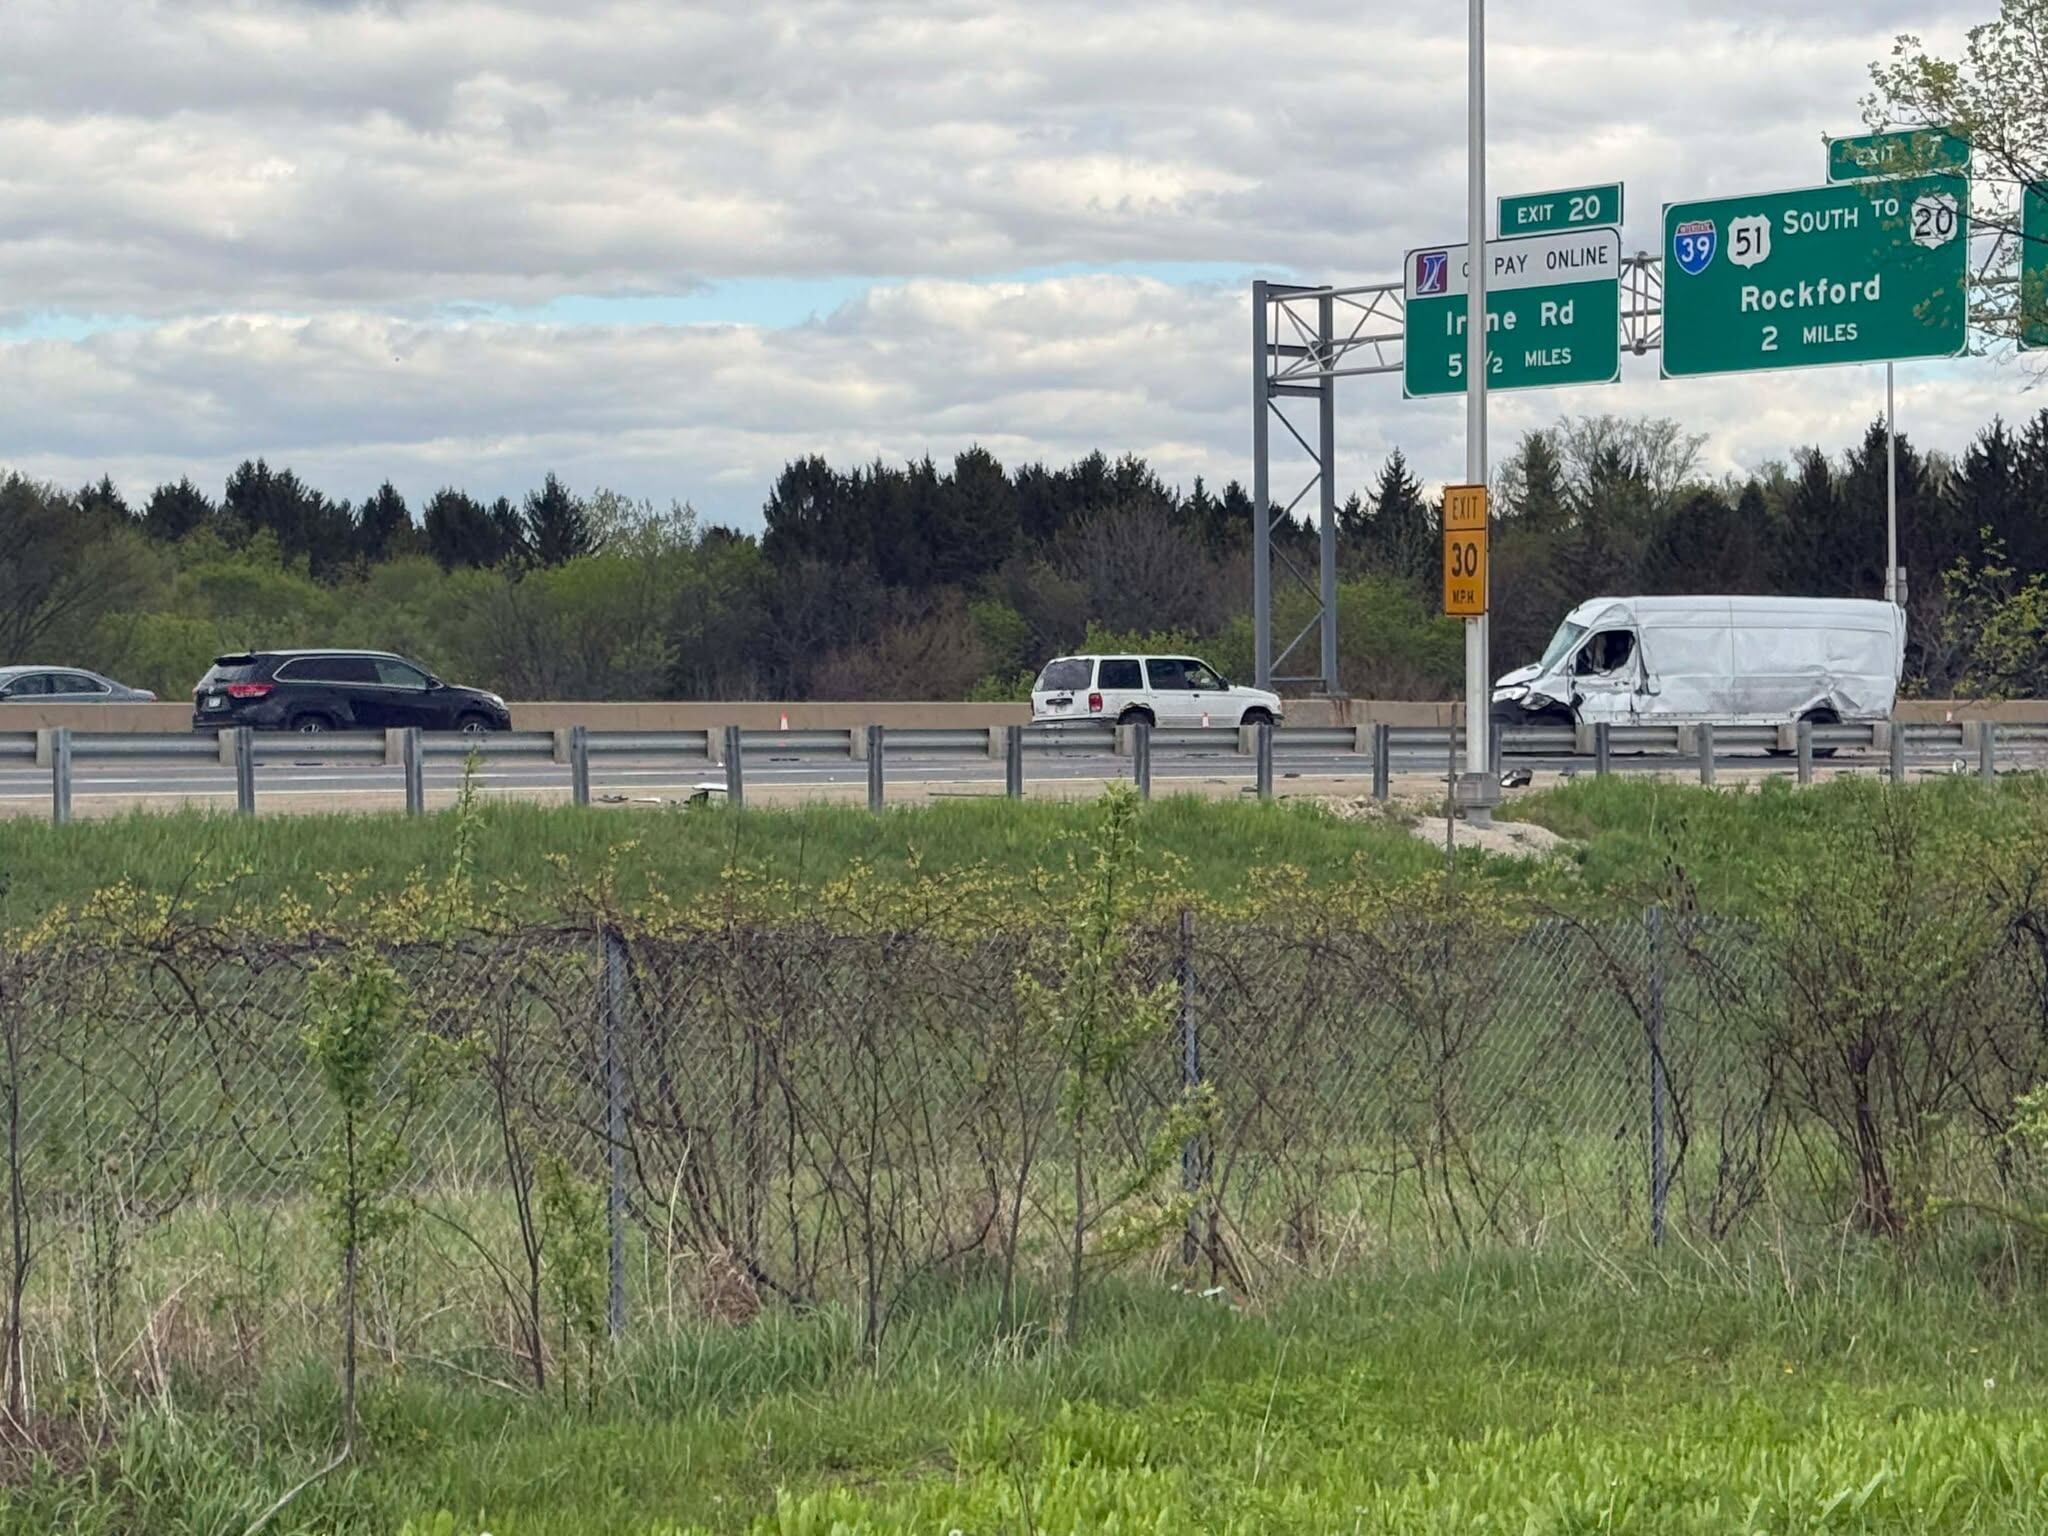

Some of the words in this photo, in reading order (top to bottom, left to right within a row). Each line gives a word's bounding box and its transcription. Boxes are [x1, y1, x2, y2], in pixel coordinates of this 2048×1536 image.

[1517, 204, 1555, 225] EXIT
[1567, 194, 1601, 221] 20
[1783, 207, 1859, 235] SOUTH
[1871, 198, 1899, 217] TO
[1914, 205, 1953, 238] 20
[1681, 236, 1711, 263] 39
[1736, 226, 1762, 256] 51
[1494, 254, 1528, 276] PAY
[1546, 245, 1608, 270] ONLINE
[1741, 272, 1881, 312] Rockford
[1446, 310, 1517, 336] Irne
[1540, 299, 1574, 327] Rd
[1761, 325, 1779, 351] 2
[1803, 323, 1858, 344] MILES
[1448, 353, 1463, 377] 5
[1525, 347, 1572, 368] MILES
[1452, 496, 1478, 520] EXIT
[1451, 542, 1478, 577] 30
[1452, 589, 1474, 604] MPH
